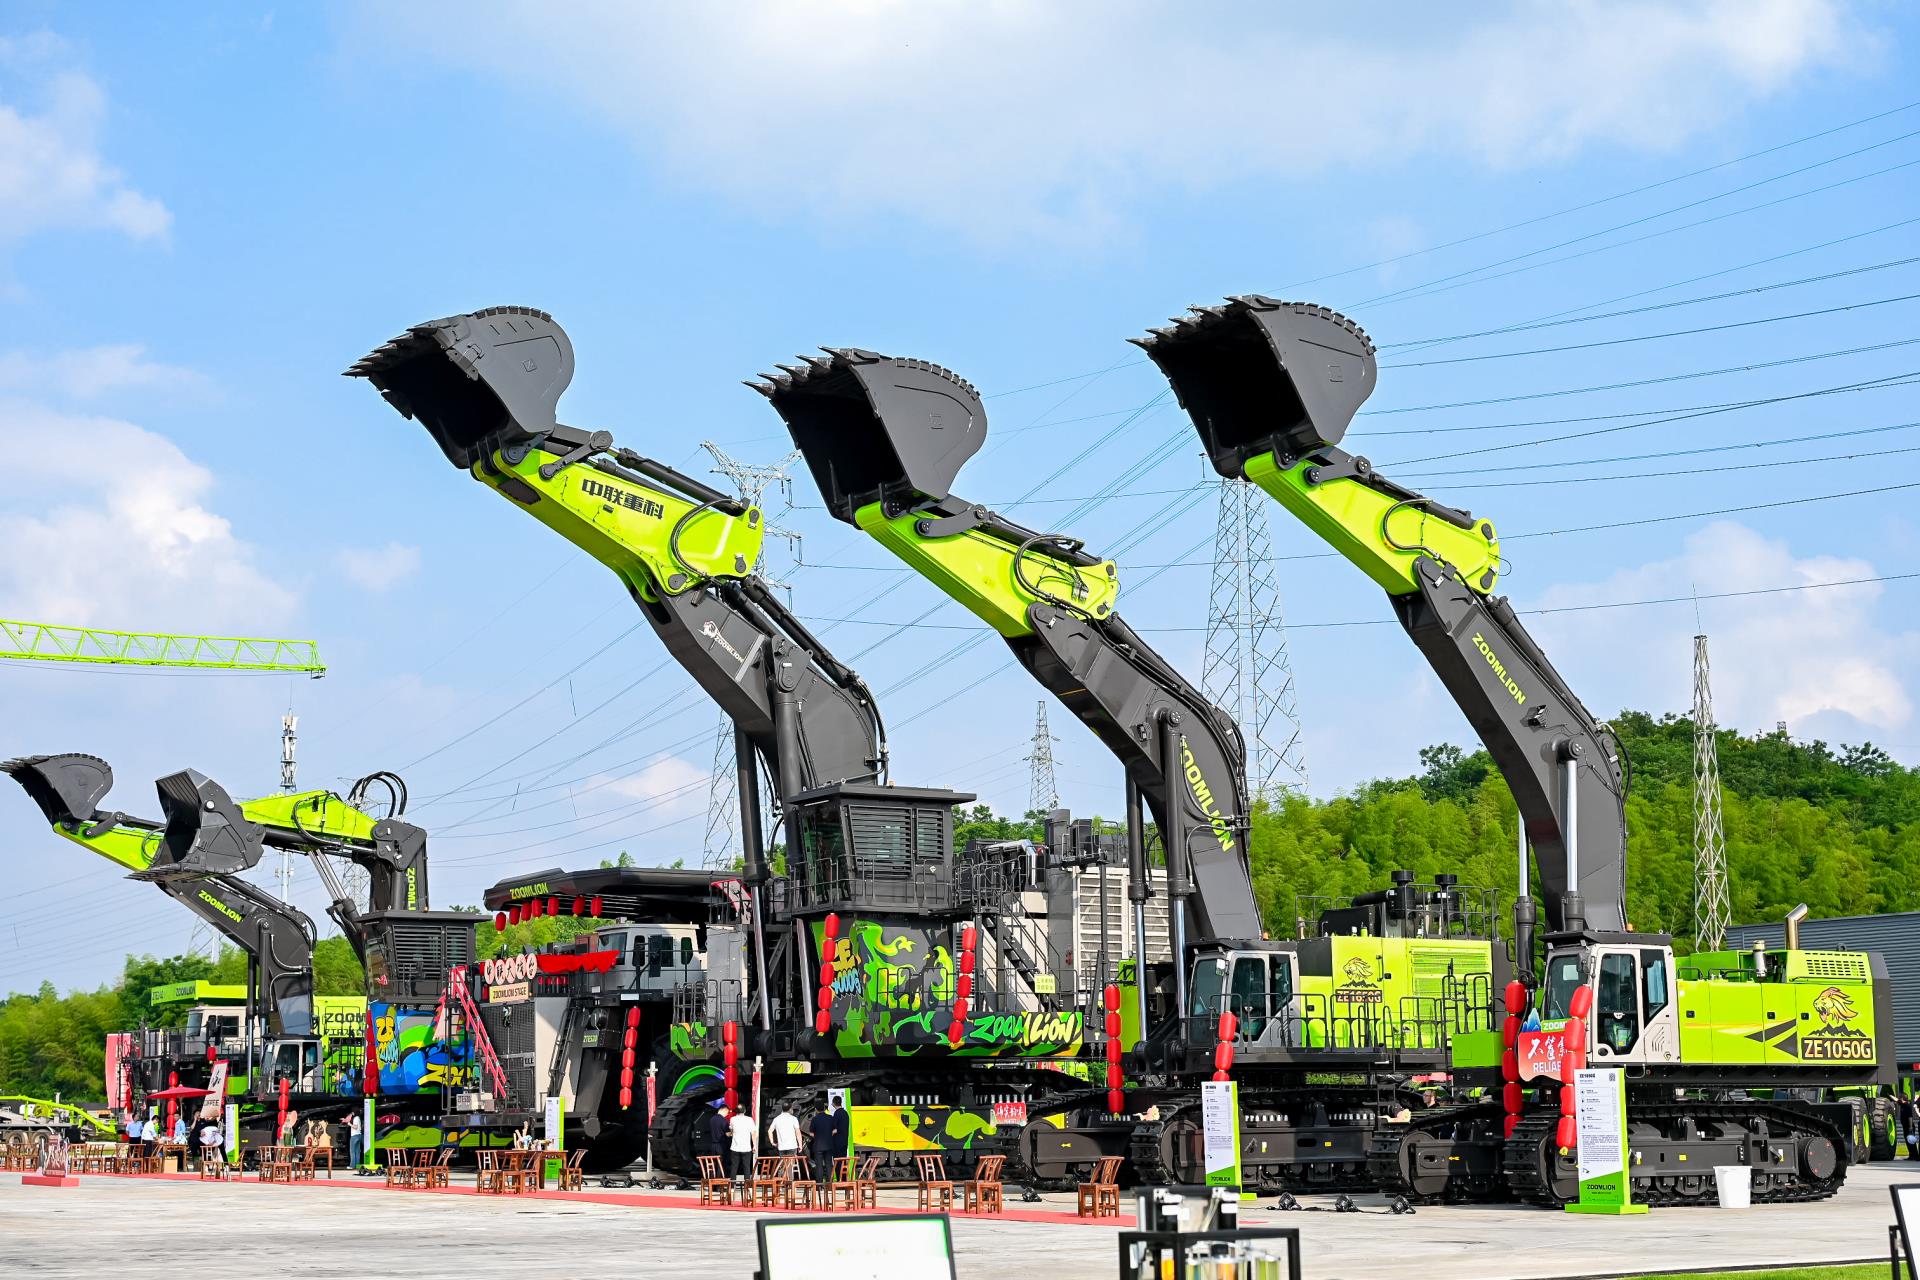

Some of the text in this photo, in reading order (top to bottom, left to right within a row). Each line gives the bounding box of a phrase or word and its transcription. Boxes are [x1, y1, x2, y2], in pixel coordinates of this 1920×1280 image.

[582, 478, 664, 520] 中联重科
[1471, 632, 1526, 705] ZOOMLION
[1180, 739, 1235, 852] OOMLION
[198, 889, 243, 923] ZOOMLION
[509, 882, 549, 900] ZOOMLION
[1803, 1039, 1872, 1059] ZE1050G
